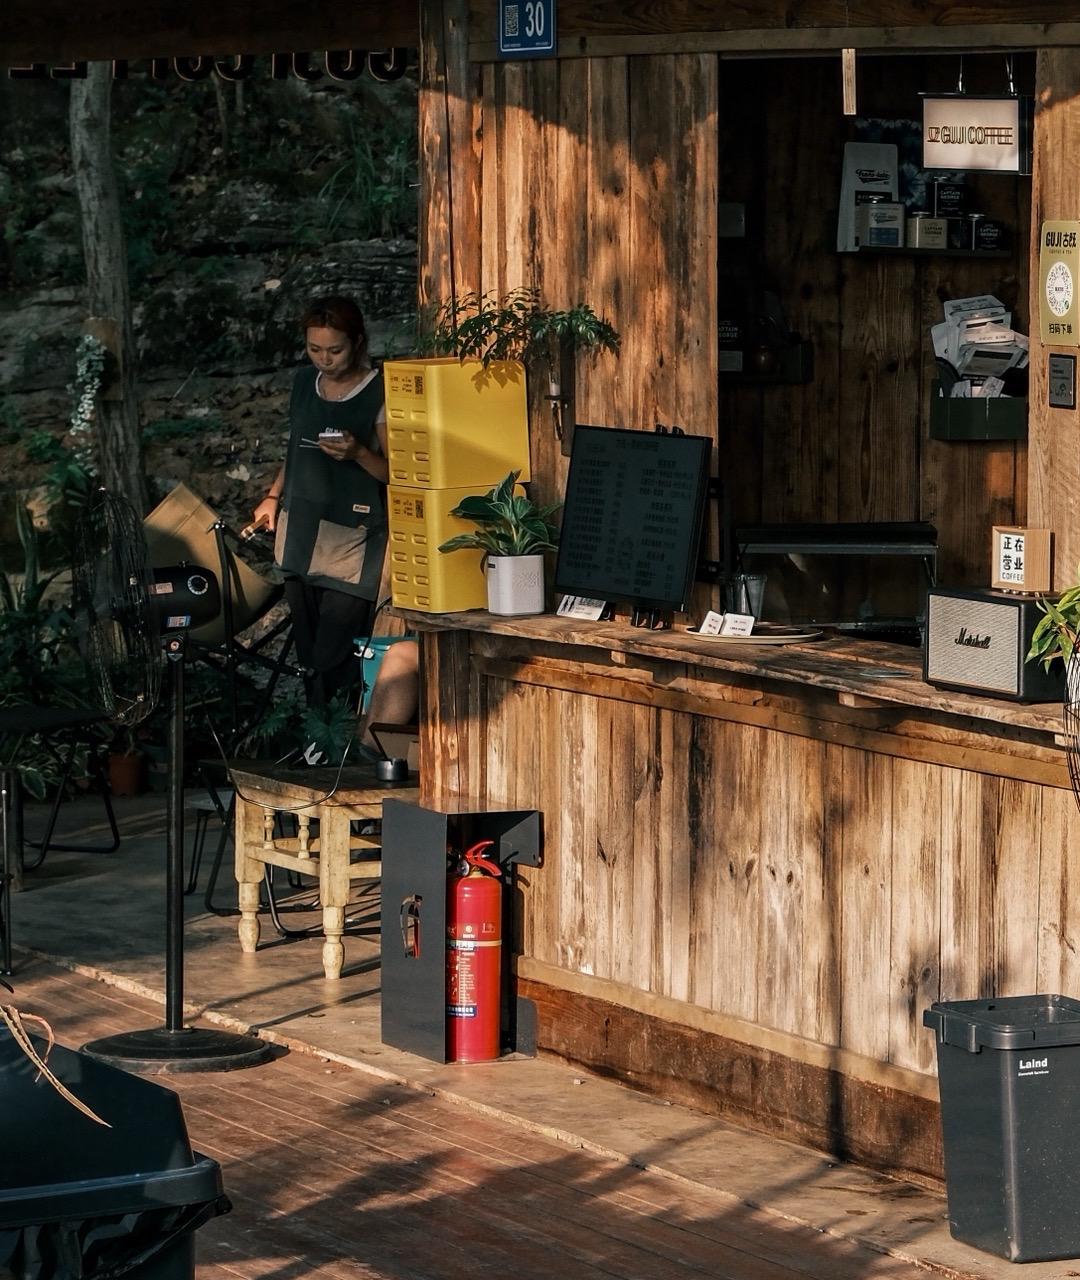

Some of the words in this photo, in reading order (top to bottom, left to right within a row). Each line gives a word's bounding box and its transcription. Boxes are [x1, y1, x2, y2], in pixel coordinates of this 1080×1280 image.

[525, 1, 544, 37] 30
[941, 126, 966, 145] GUJI
[967, 126, 1013, 145] COFFEE
[1046, 231, 1062, 247] GUJI
[1049, 323, 1072, 335] 扫码下单
[1003, 536, 1024, 552] 正在
[1002, 554, 1023, 570] 营业
